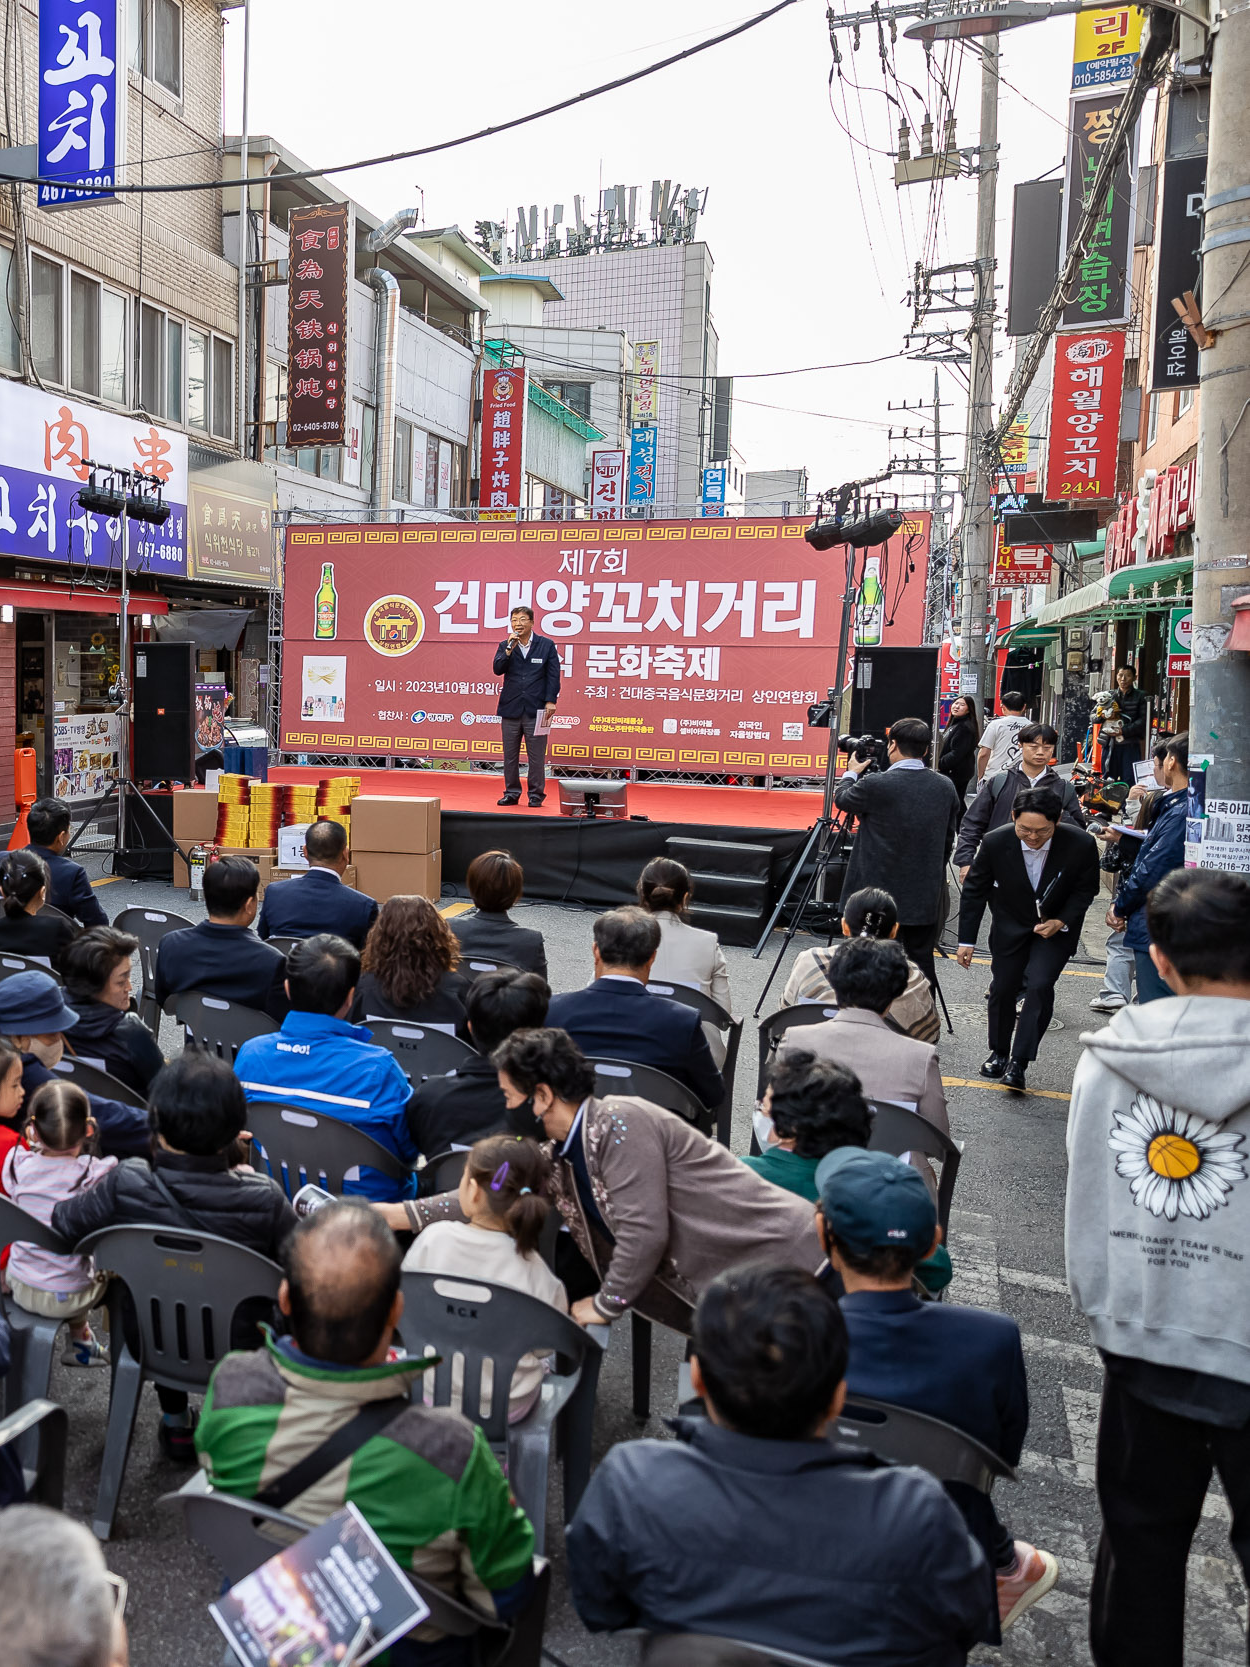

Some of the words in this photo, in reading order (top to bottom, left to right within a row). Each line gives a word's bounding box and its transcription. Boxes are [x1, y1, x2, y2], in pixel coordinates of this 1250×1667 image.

[1093, 5, 1128, 37] 리
[1097, 41, 1125, 56] 2F
[1074, 66, 1135, 86] 010-5854-23
[292, 420, 339, 432] 02-6405-8786
[1063, 366, 1104, 479] 해월양꼬치
[1061, 480, 1101, 495] 24시
[137, 541, 183, 562] 467-6880
[558, 548, 628, 577] 제7회
[433, 578, 818, 639] 건대양꼬치거리
[584, 645, 721, 682] 문화축제
[375, 680, 396, 692] 일시
[406, 680, 502, 696] 2023년10월18일(
[583, 686, 608, 698] 주최
[619, 686, 743, 703] 건대중국음식문화거리
[752, 690, 818, 704] 상인연합회
[378, 711, 403, 721] 협찬사
[737, 721, 763, 730] 외국인
[1180, 1239, 1208, 1252] TEAM
[1170, 1247, 1178, 1257] A
[1182, 1249, 1210, 1263] HAVE
[1170, 1258, 1190, 1269] YOU
